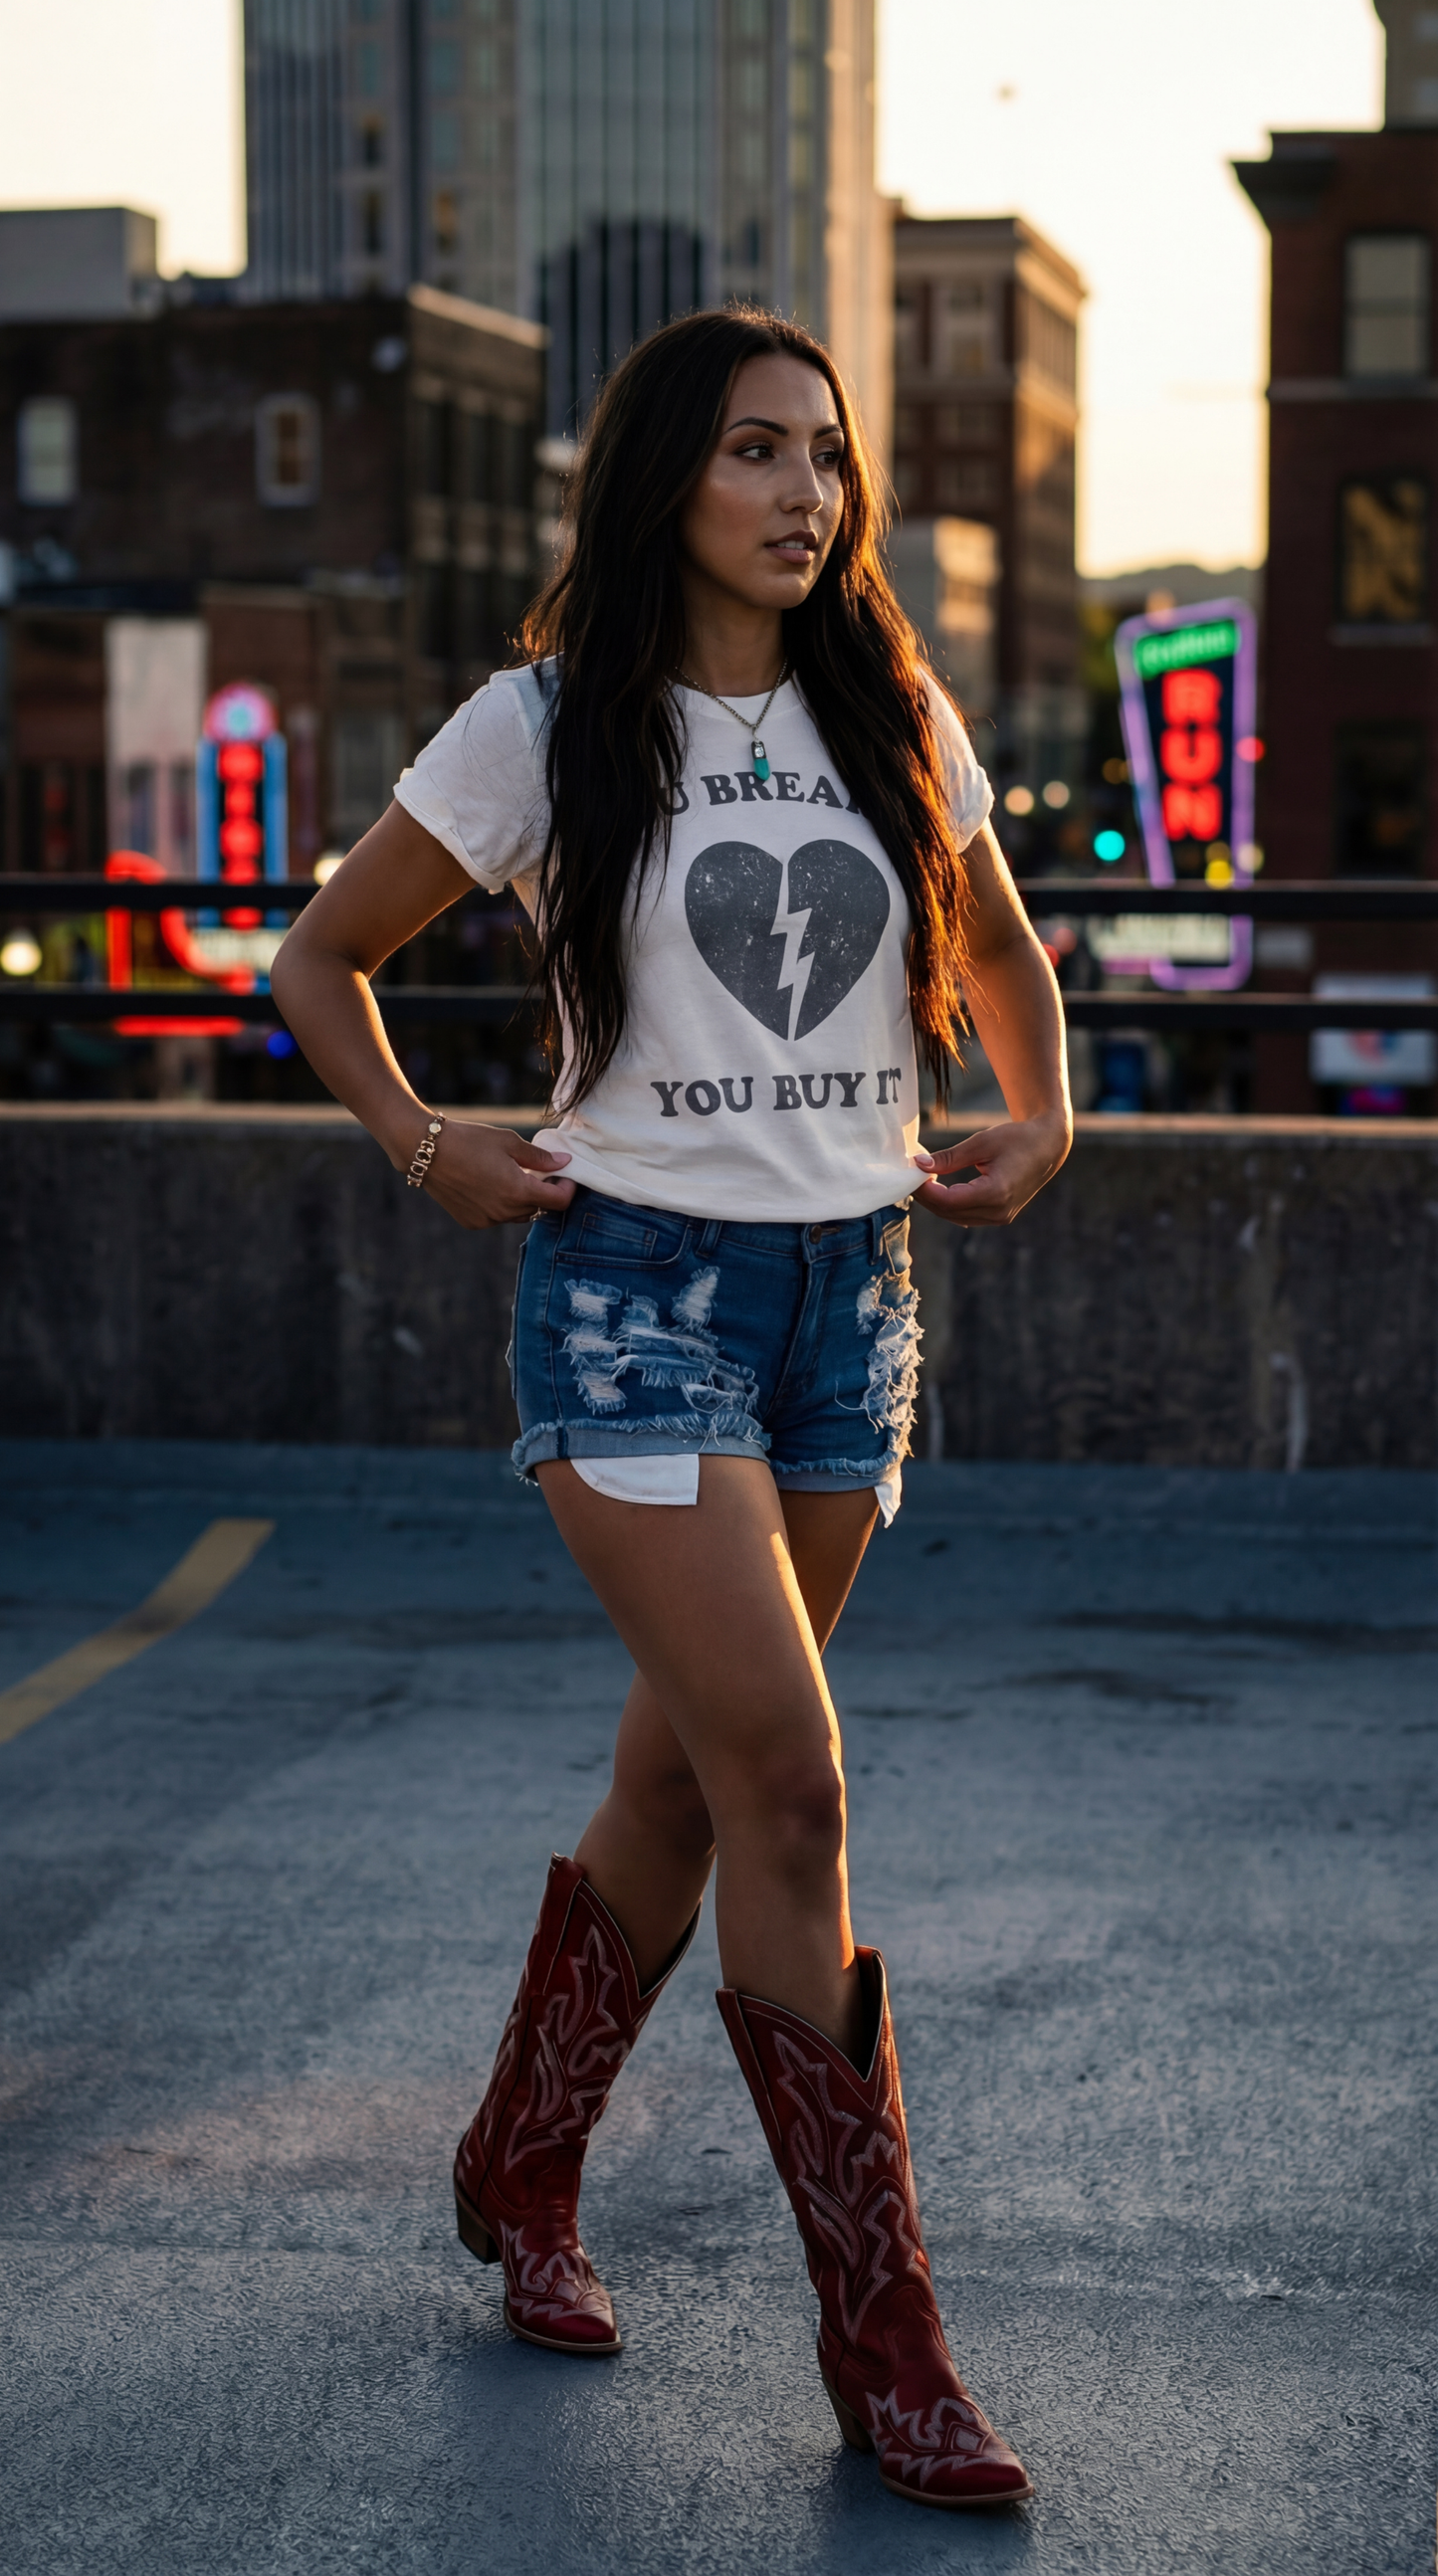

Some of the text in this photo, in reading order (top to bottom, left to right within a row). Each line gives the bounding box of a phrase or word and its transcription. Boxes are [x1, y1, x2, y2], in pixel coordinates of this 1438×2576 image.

[701, 771, 862, 814] BREA
[650, 1068, 901, 1117] YOU BUY IT
